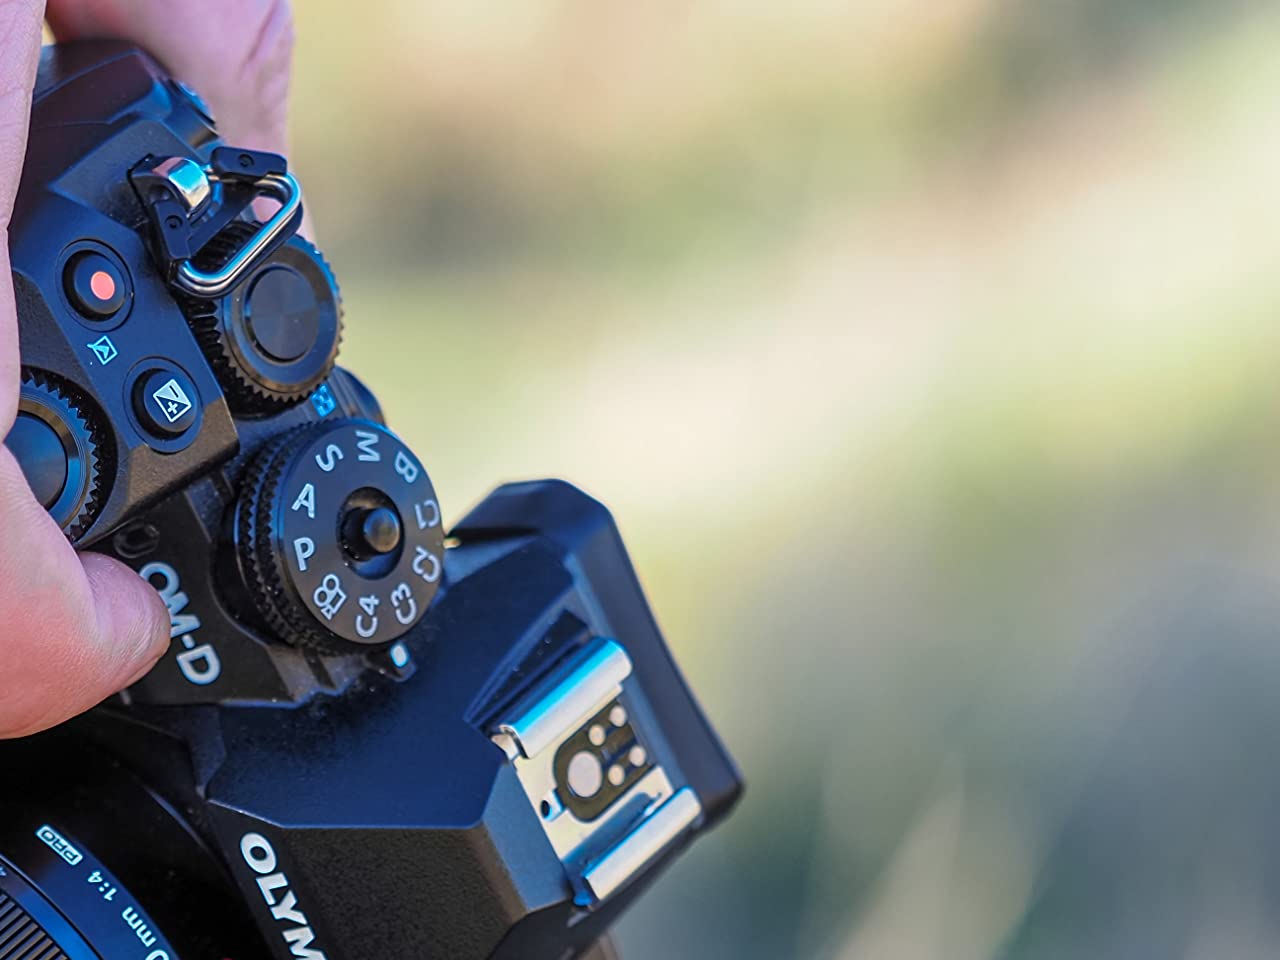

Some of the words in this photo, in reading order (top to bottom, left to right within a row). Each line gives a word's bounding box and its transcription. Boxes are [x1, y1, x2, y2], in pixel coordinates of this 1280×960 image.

[315, 444, 344, 472] S
[355, 430, 381, 462] M
[394, 451, 418, 483] B
[291, 483, 315, 519] A
[415, 500, 440, 529] C1
[294, 537, 314, 571] P
[412, 546, 441, 583] C2
[355, 595, 379, 638] C4
[391, 583, 417, 625] C3
[39, 828, 80, 863] PRO
[87, 871, 117, 901] 1:4
